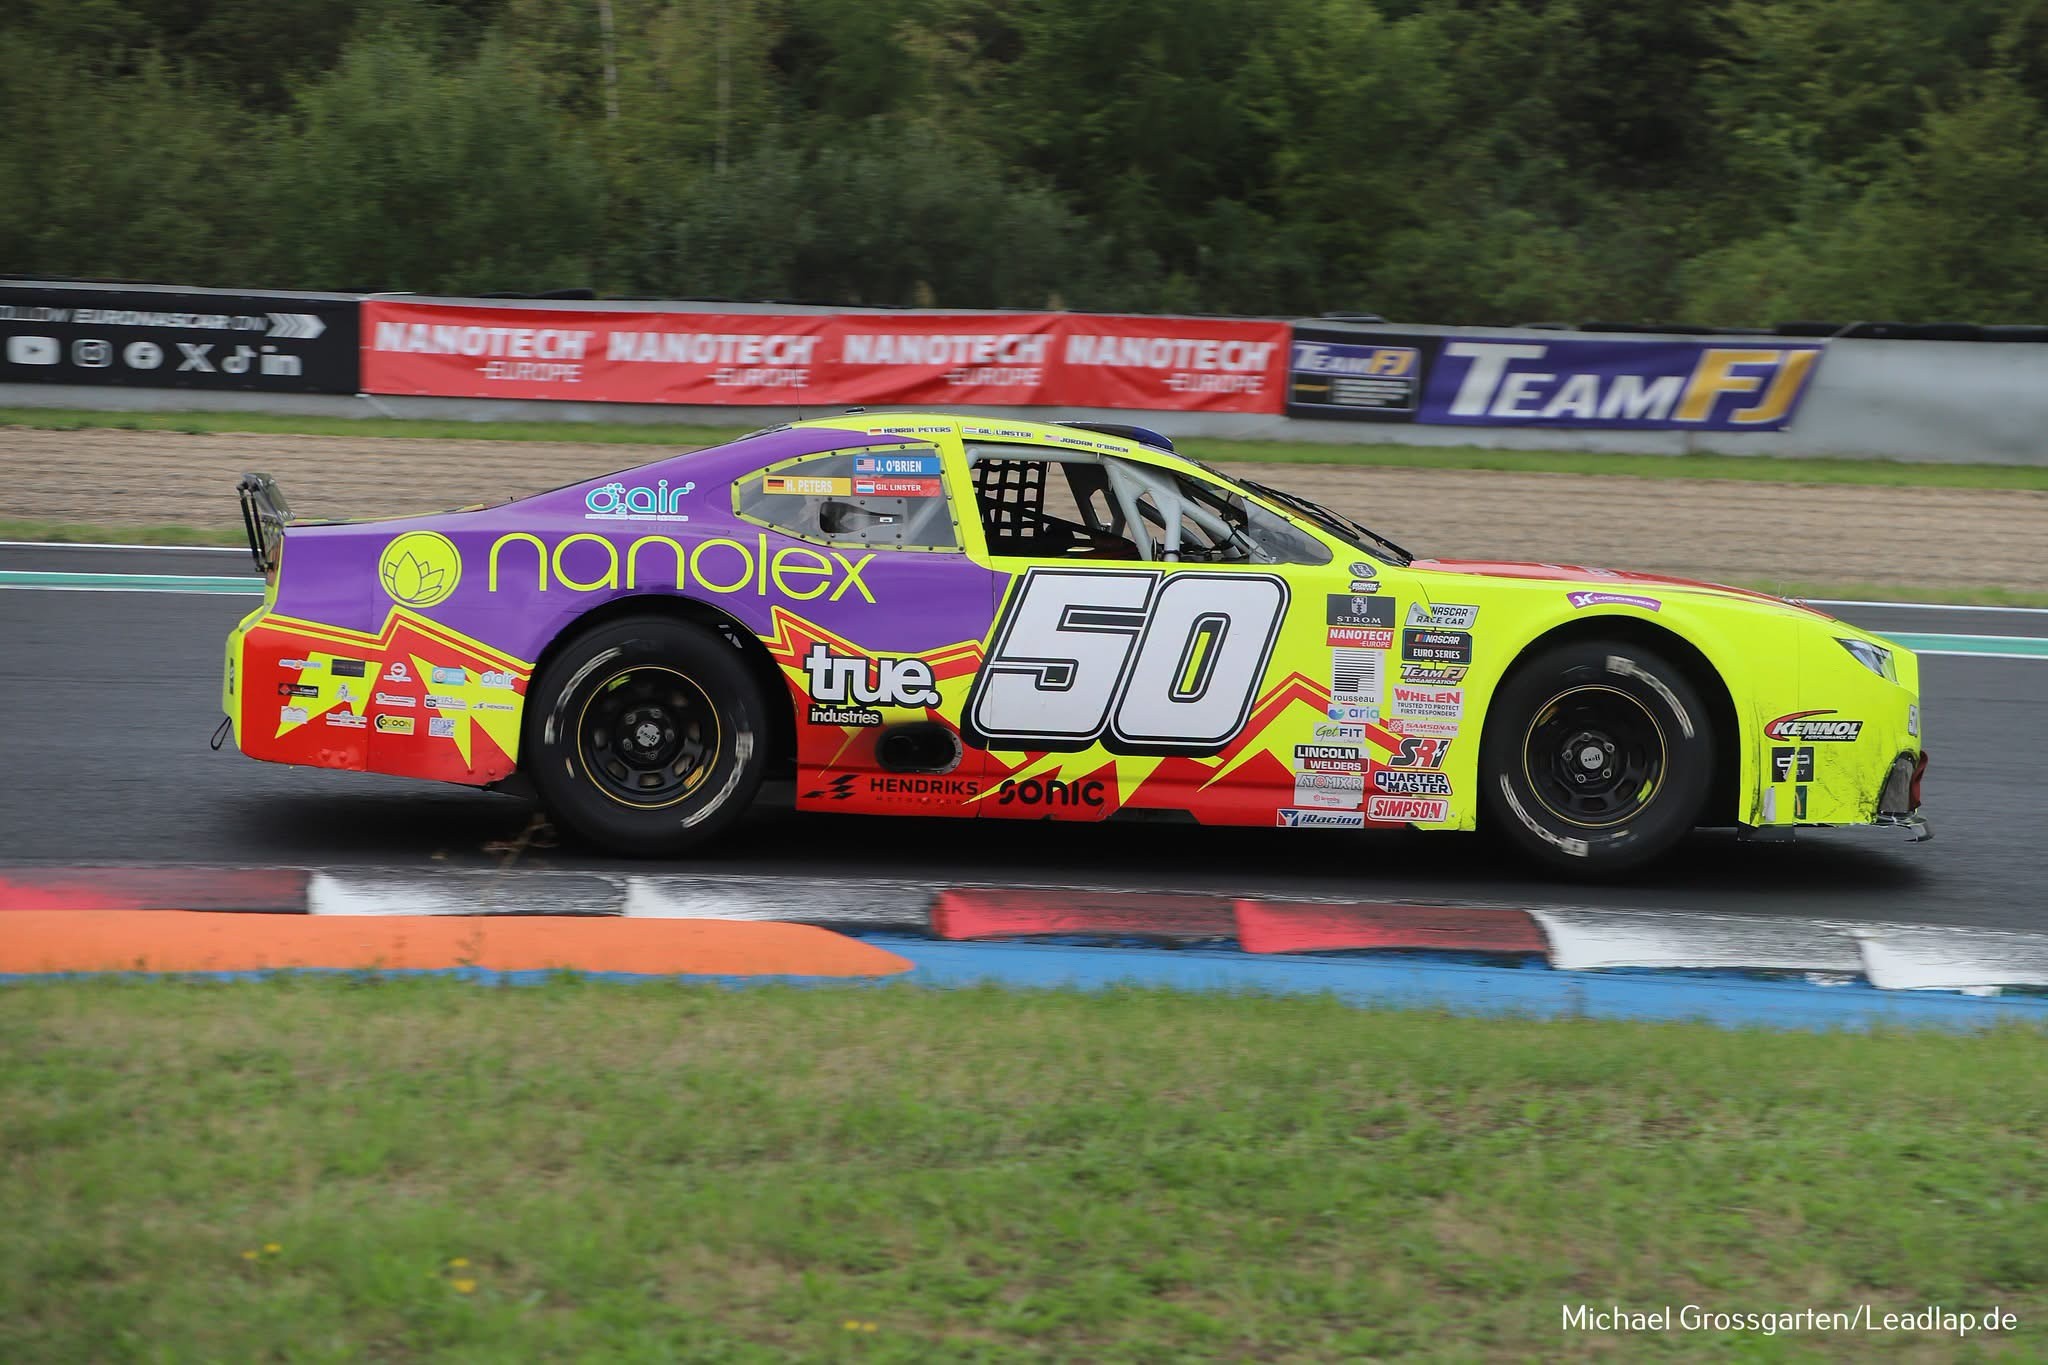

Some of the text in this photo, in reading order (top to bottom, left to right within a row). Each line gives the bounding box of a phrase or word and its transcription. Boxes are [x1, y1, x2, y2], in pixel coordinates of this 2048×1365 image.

[374, 321, 591, 360] NANOTECH
[607, 331, 819, 365] NANOTECH
[843, 333, 1051, 365] NANOTECH
[1065, 334, 1276, 371] NANOTECH
[996, 430, 1032, 438] LINSTER
[1060, 437, 1093, 447] JORDAN
[875, 460, 922, 473] J. O'BRIEN
[786, 481, 832, 493] H. PETERS
[876, 484, 921, 492] GIL LINSTER
[488, 532, 877, 604] nanolex
[1430, 606, 1468, 617] NASCAR
[1416, 615, 1464, 625] RACE CAR
[1330, 629, 1391, 641] NANOTECH
[1424, 634, 1460, 645] NASCAR
[1413, 648, 1460, 659] EURO SERIES
[962, 565, 1291, 758] 50
[1333, 695, 1375, 703] rousseau
[1395, 688, 1460, 704] WHELEN
[811, 707, 879, 724] industries
[1348, 706, 1379, 718] aria
[1418, 709, 1456, 717] RESPONDERS
[1405, 722, 1457, 731] SAMSONAS
[1772, 722, 1859, 735] KENNOL
[1297, 746, 1356, 760] LINCOLN
[1310, 760, 1361, 771] WELDERS
[1376, 772, 1445, 786] QUARTER
[870, 778, 978, 795] HENDRIKS
[1388, 782, 1448, 793] MASTER
[1373, 799, 1442, 819] SIMPSON
[1301, 814, 1362, 826] iRacing
